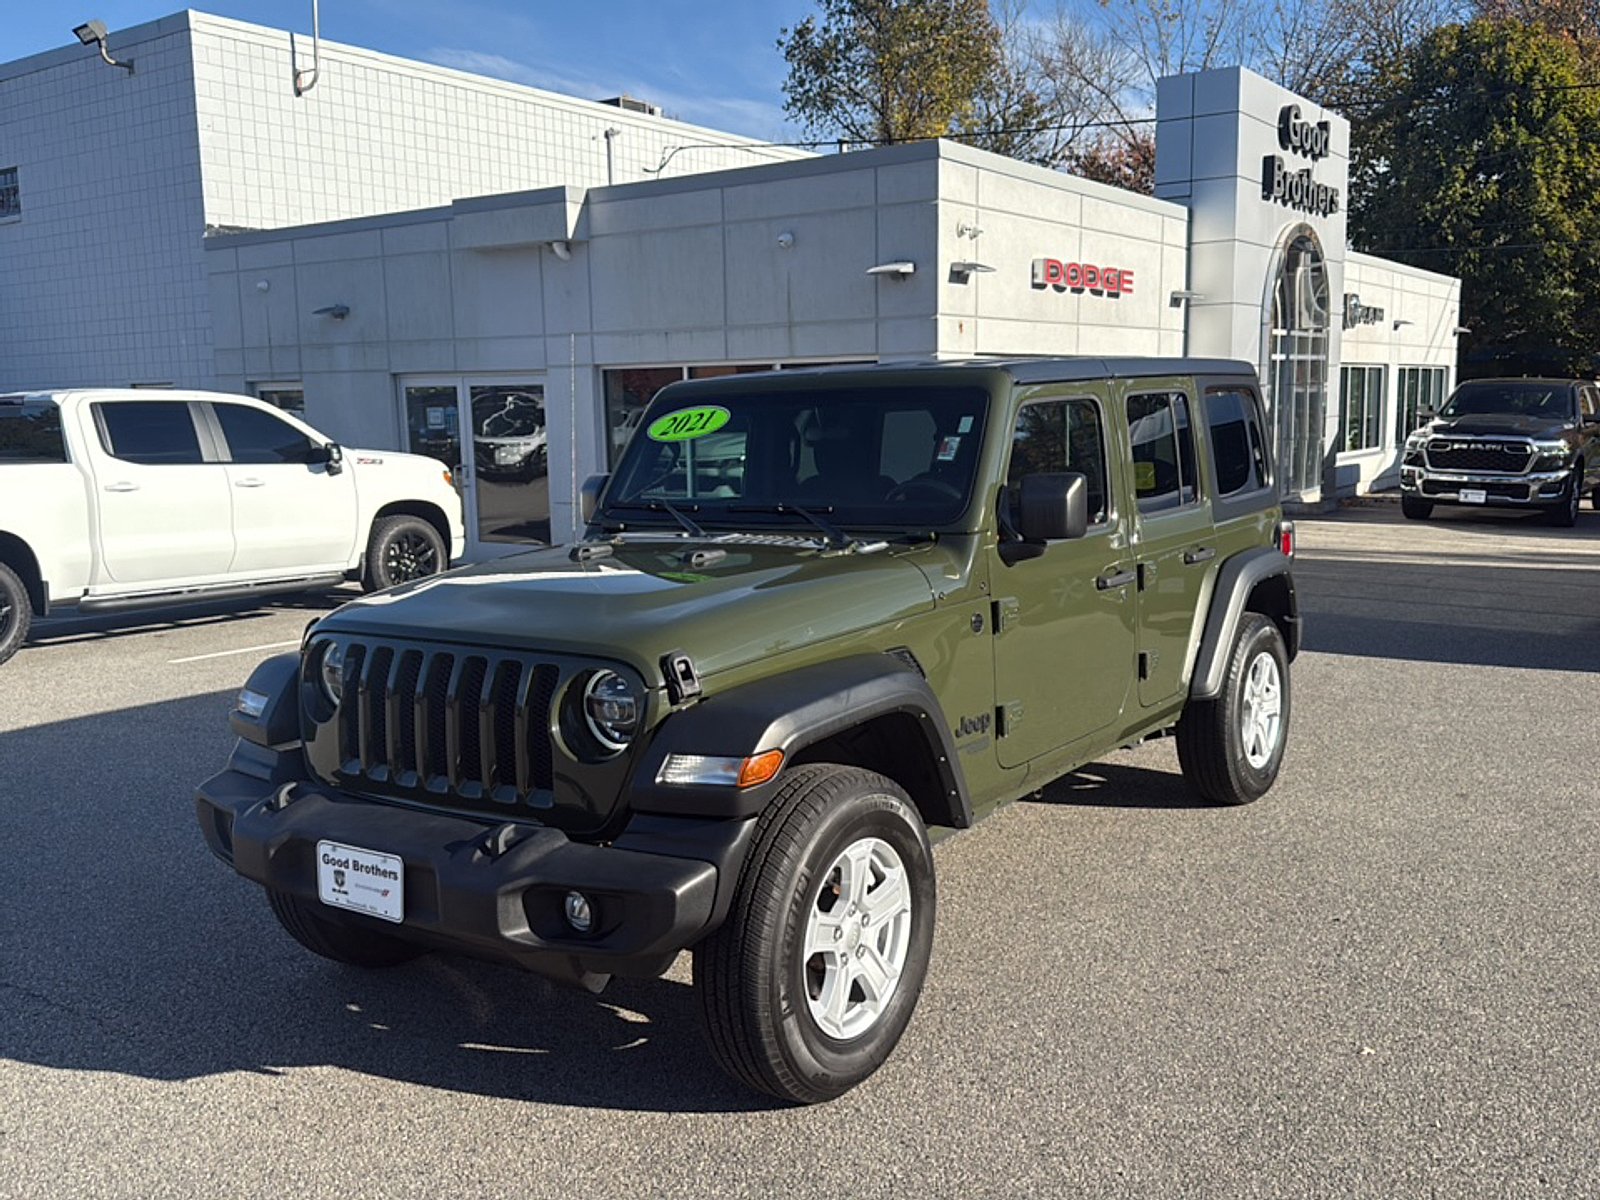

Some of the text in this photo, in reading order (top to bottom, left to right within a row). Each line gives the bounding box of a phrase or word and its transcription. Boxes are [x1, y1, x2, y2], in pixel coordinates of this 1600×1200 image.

[1286, 103, 1331, 158] Good
[1271, 154, 1340, 214] Brothers
[1044, 258, 1134, 294] DODGE
[658, 410, 717, 436] 2021
[955, 713, 991, 738] Jeep
[322, 853, 399, 881] Good Brothers
